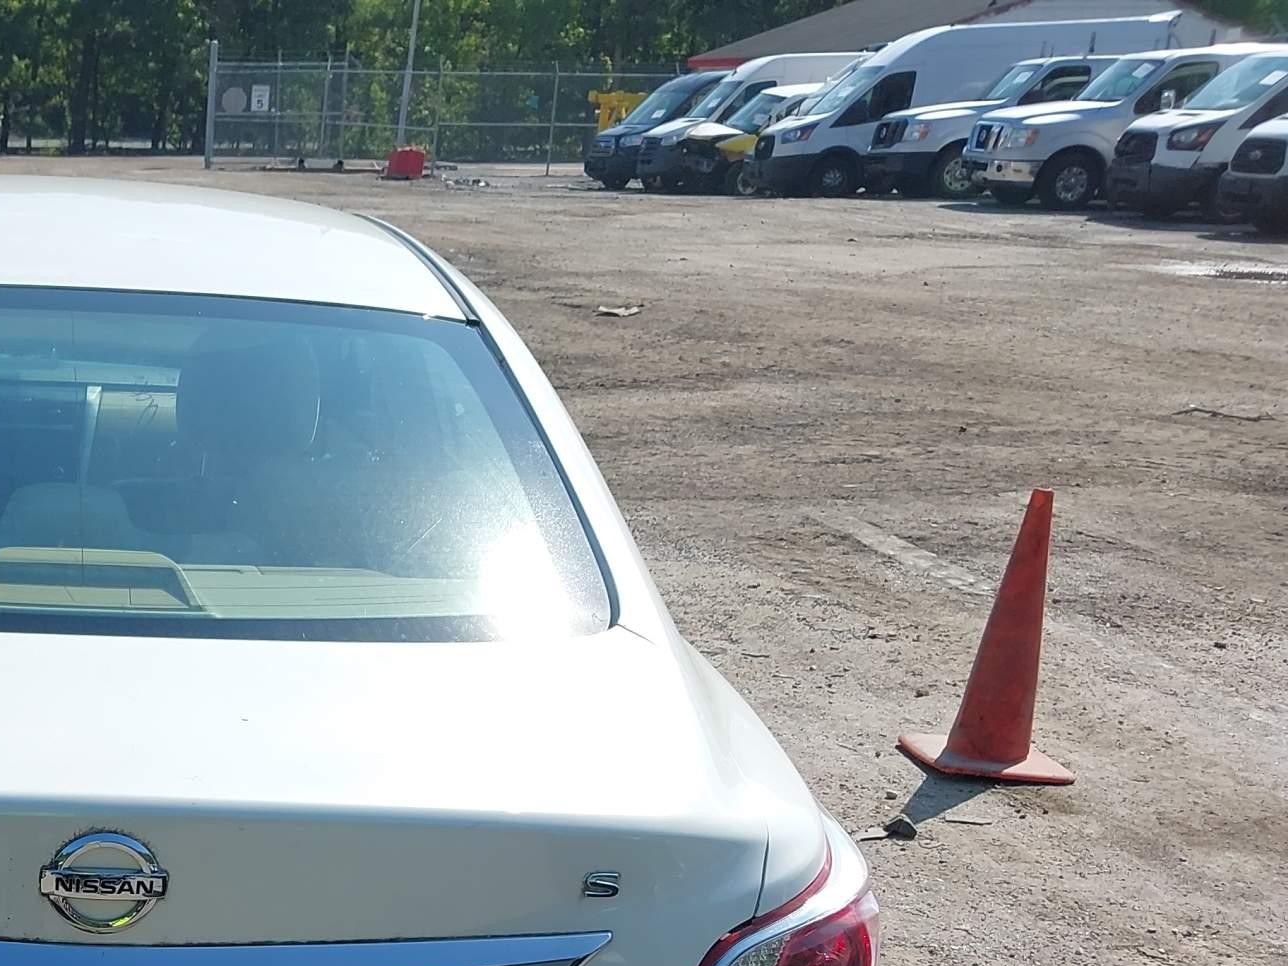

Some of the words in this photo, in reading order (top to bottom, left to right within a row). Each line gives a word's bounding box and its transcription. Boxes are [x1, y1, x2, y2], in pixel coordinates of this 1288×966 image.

[256, 98, 264, 110] 5
[54, 875, 154, 895] NISSAN
[584, 872, 621, 898] S
